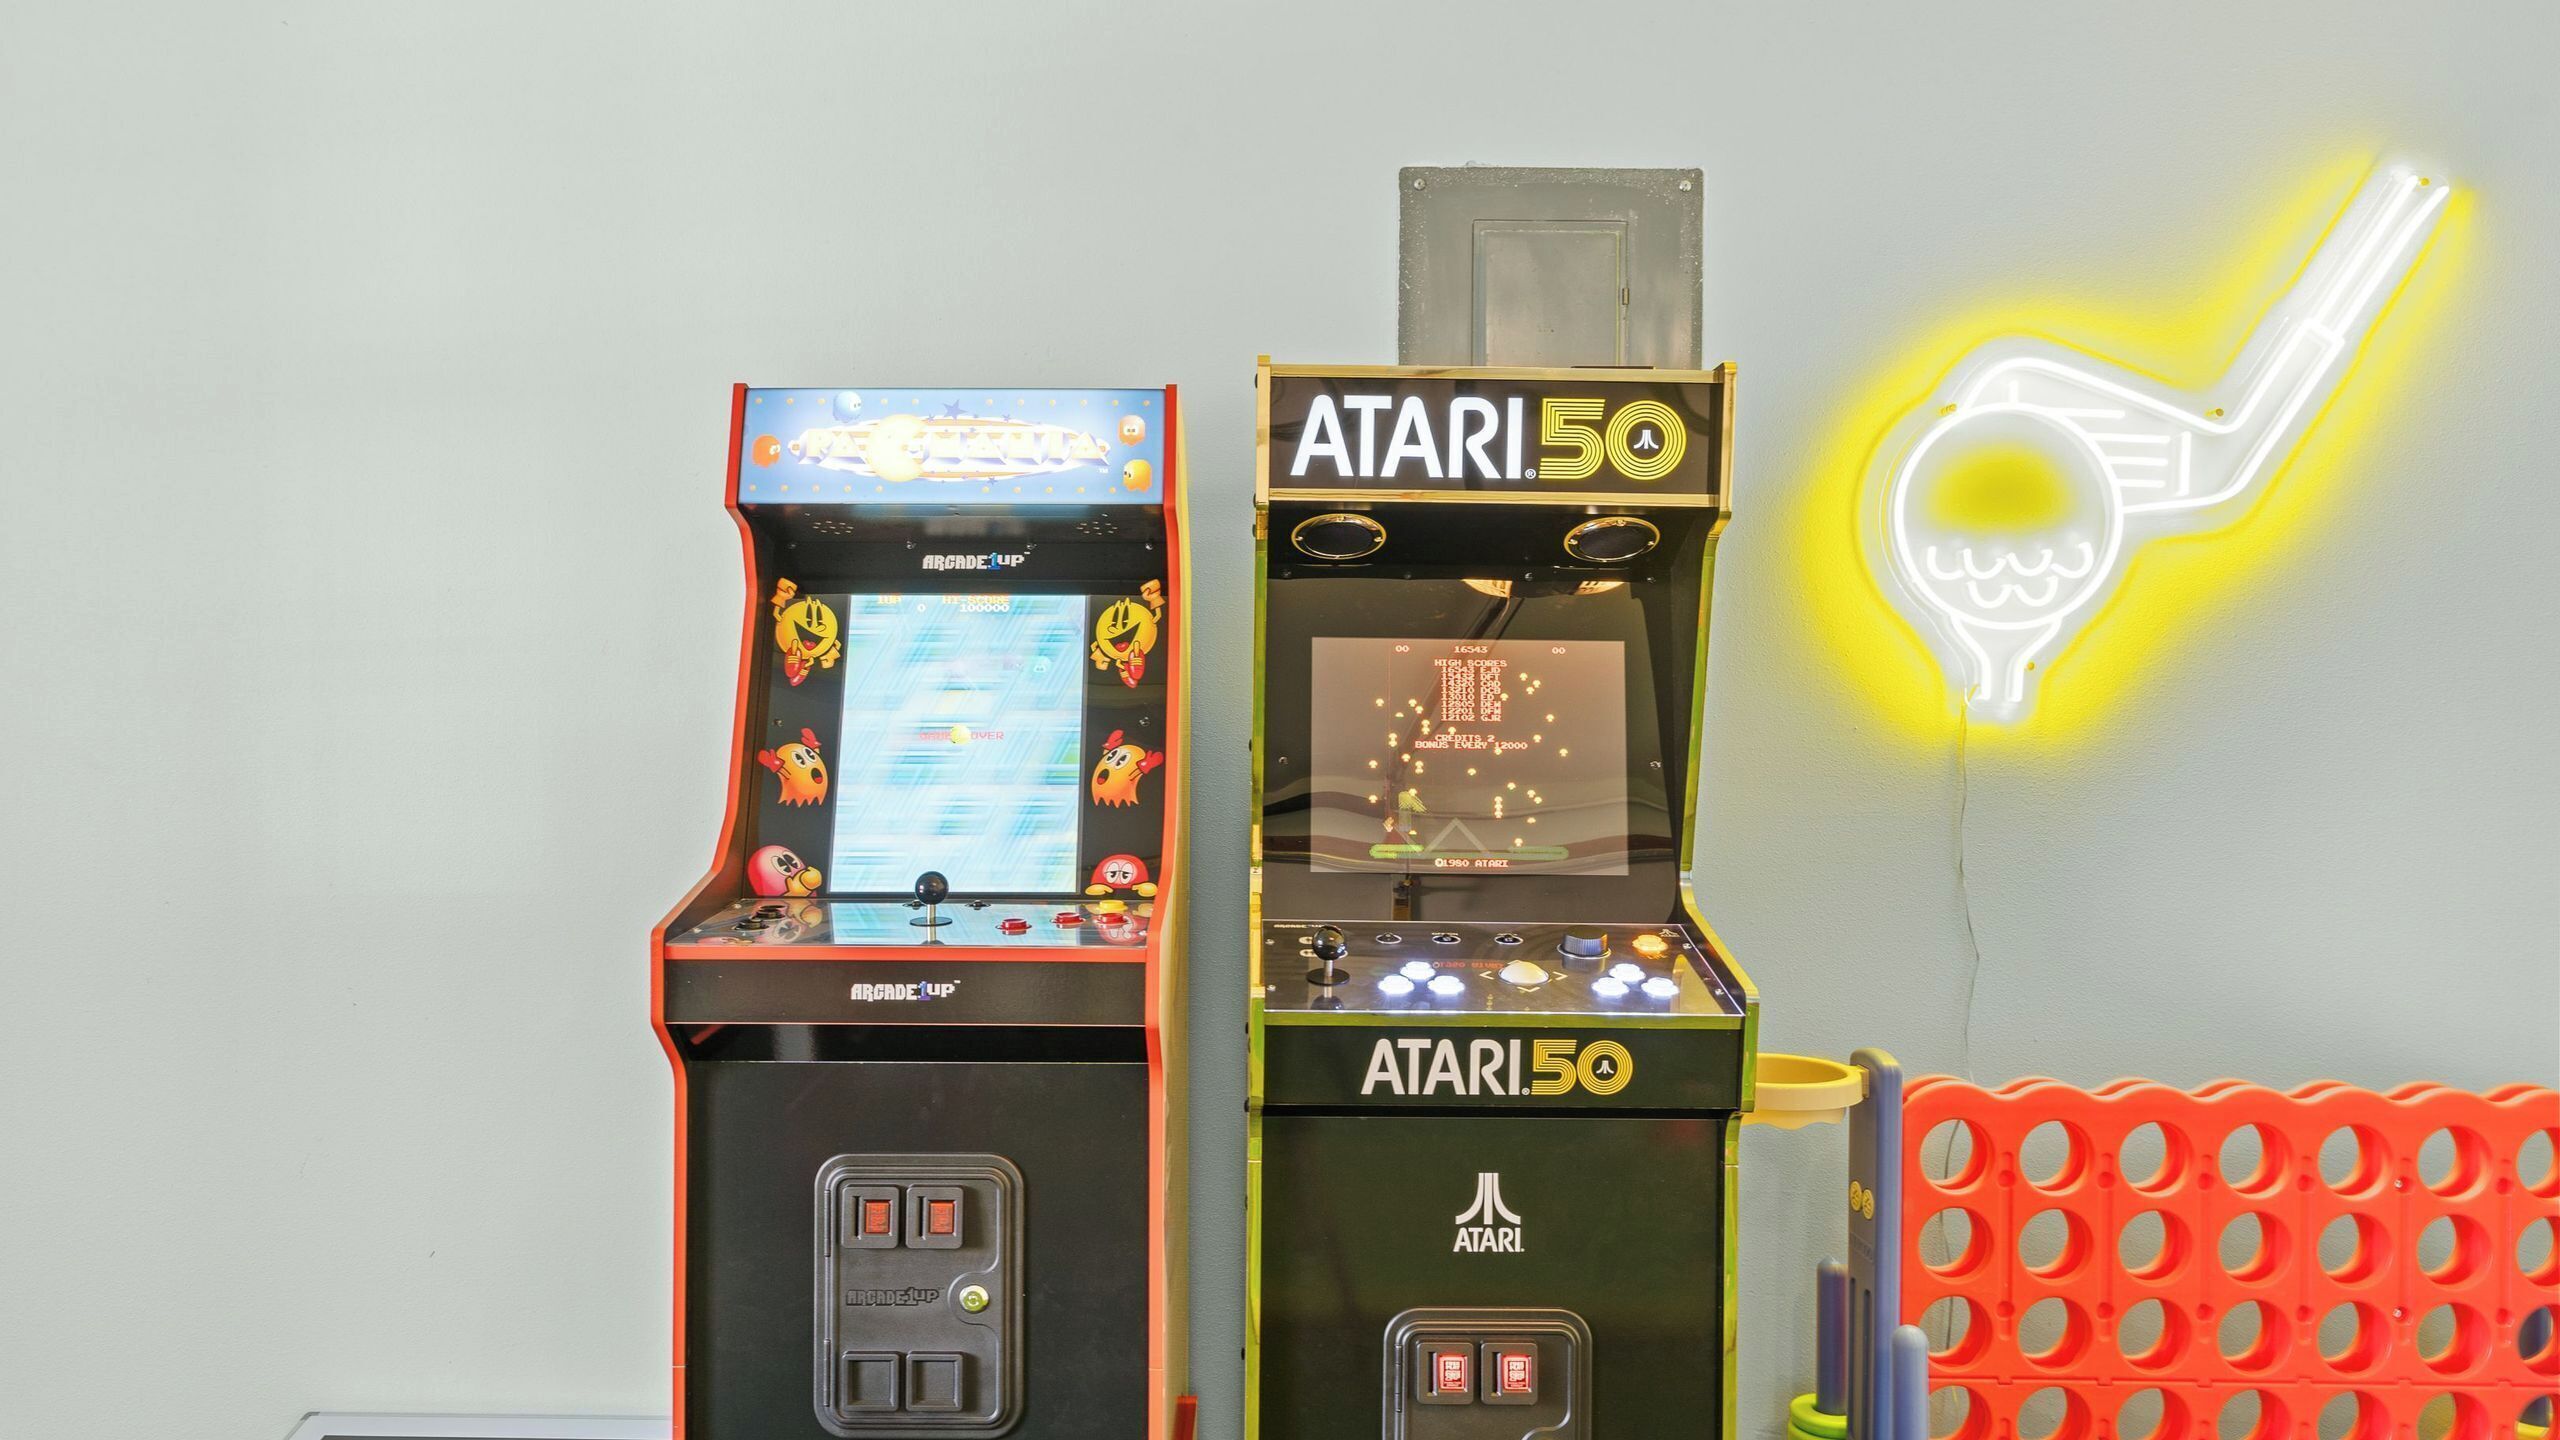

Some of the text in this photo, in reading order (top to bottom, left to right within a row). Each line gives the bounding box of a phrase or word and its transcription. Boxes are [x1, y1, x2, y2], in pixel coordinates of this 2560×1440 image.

[1538, 397, 1688, 481] 50
[960, 604, 1010, 613] 100000
[1454, 646, 1488, 654] 16543
[1434, 659, 1508, 667] HIGH SCORES
[970, 731, 1004, 741] OVER
[1435, 734, 1495, 743] CREDITS 2
[1415, 741, 1528, 750] BONUS EVERY 12000
[1475, 859, 1509, 868] ATARI
[1531, 1039, 1634, 1096] 50
